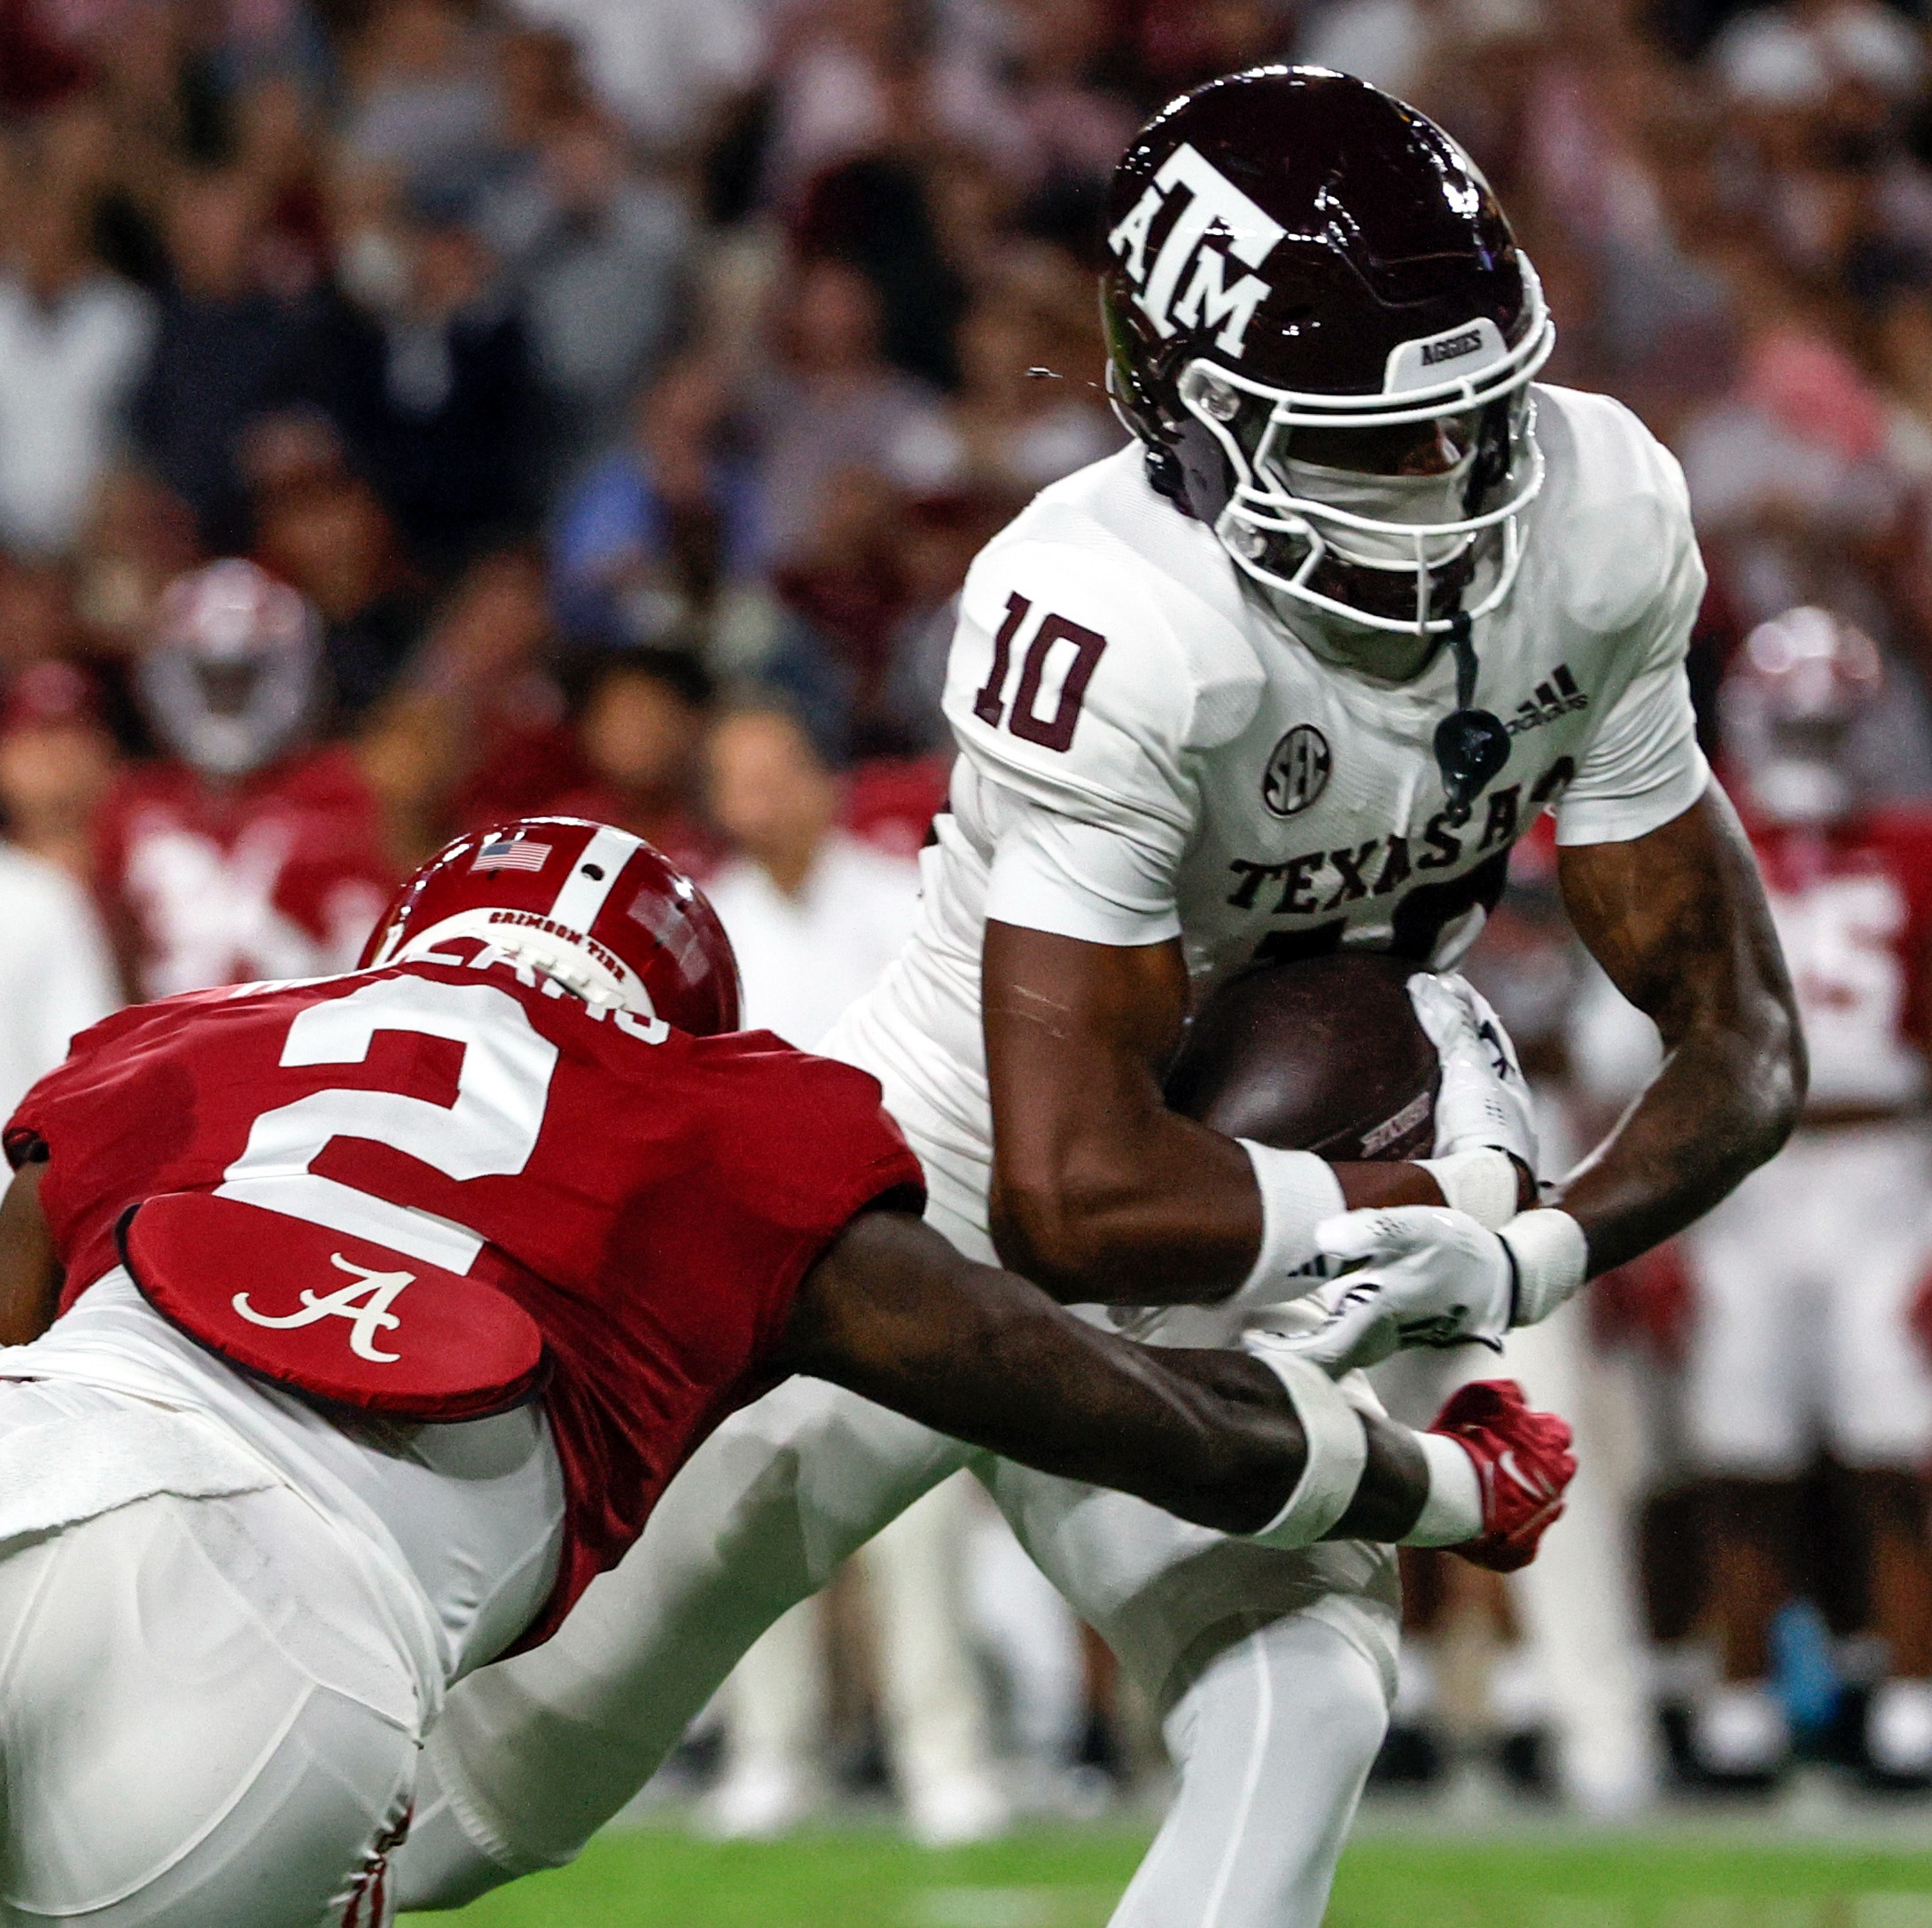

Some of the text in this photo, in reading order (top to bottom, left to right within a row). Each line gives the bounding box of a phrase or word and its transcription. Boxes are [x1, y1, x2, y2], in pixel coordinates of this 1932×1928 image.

[1421, 329, 1483, 366] AGGIES
[973, 591, 1108, 753] 10
[1266, 725, 1331, 815] SEC
[1227, 811, 1468, 916] TEXAS
[488, 911, 627, 985] CRIMSON TIDE
[211, 974, 560, 1276] 2
[231, 1252, 417, 1363] A
